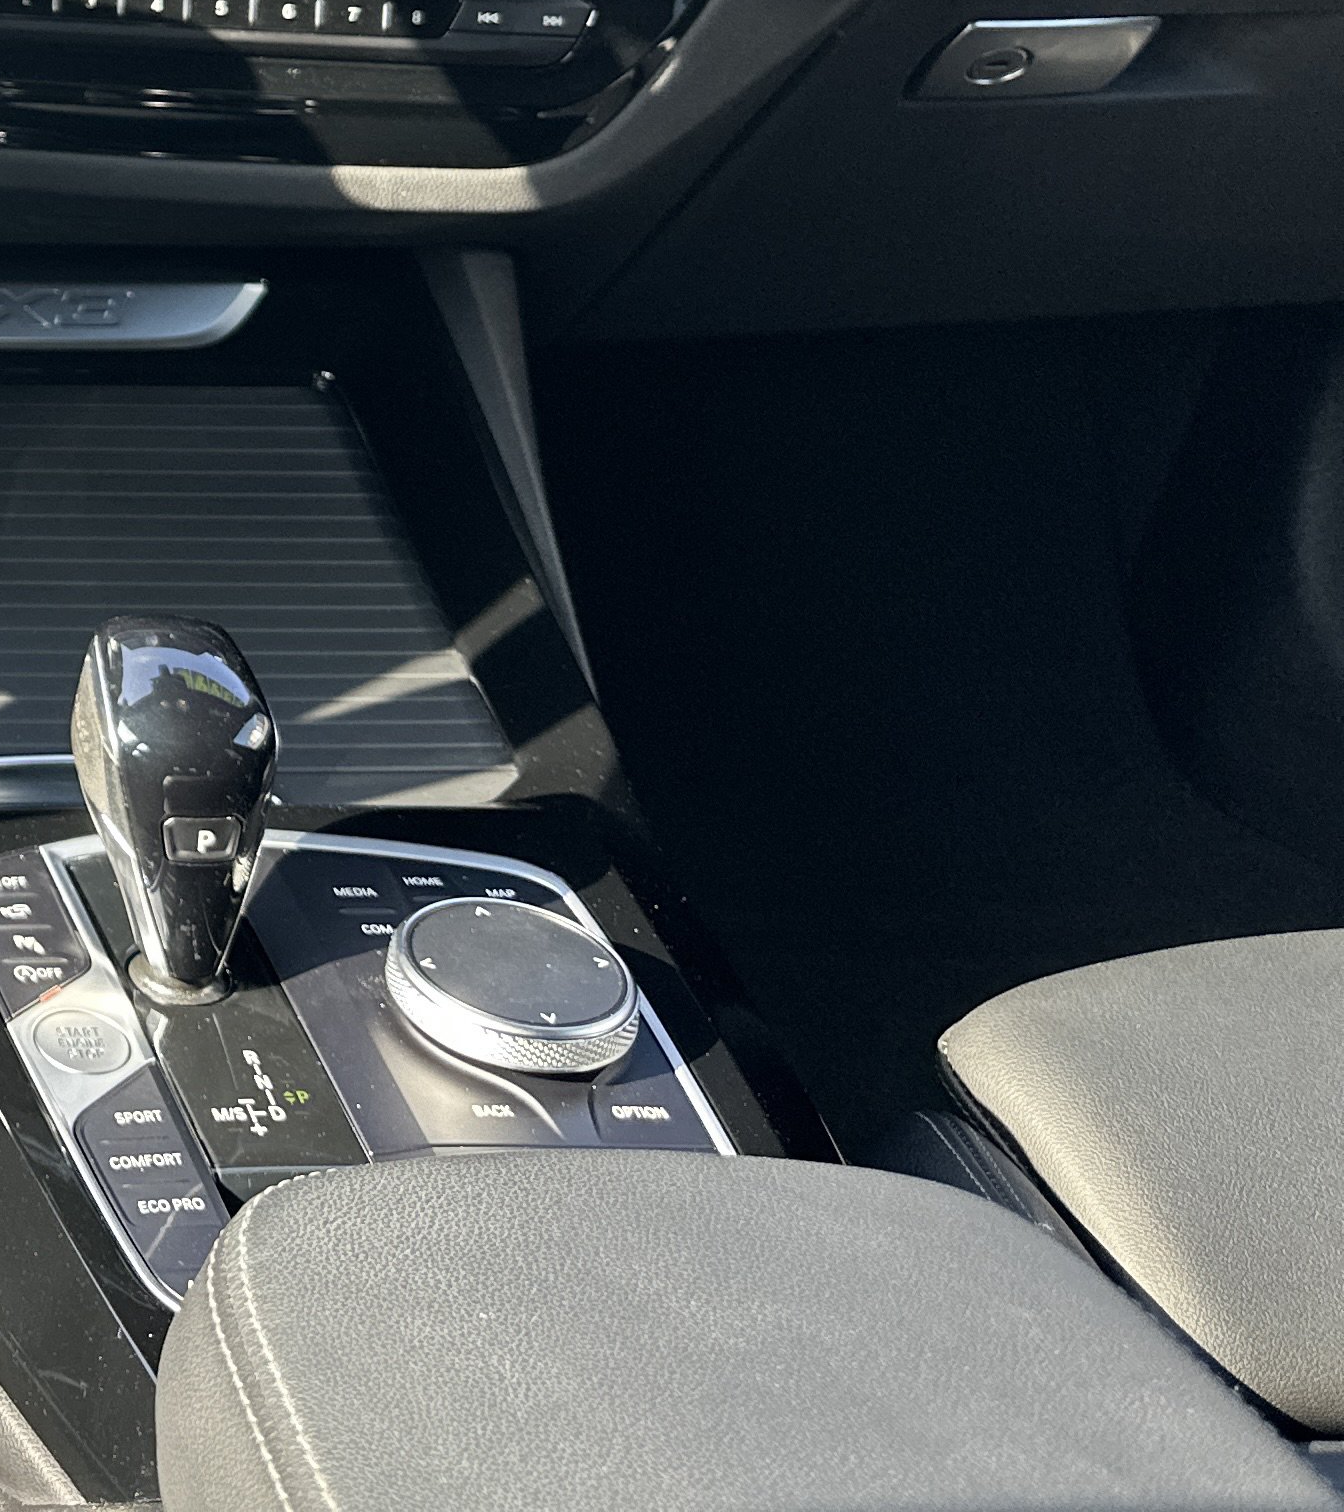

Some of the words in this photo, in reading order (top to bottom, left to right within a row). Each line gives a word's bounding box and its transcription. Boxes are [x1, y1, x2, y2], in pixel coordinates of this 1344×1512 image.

[196, 830, 217, 852] P
[1, 875, 28, 890] OFF
[401, 876, 444, 887] HOME
[332, 886, 378, 898] MEDIA
[484, 887, 516, 899] MAP
[36, 967, 63, 981] OFF
[56, 1025, 101, 1038] START
[242, 1049, 262, 1065] R
[253, 1074, 274, 1090] N
[295, 1090, 310, 1105] P
[114, 1109, 163, 1126] SPORT
[210, 1106, 249, 1123] M/S
[267, 1105, 288, 1123] D
[471, 1104, 515, 1119] BACK
[610, 1104, 671, 1121] OPTION
[108, 1152, 183, 1171] COMFORT
[137, 1199, 171, 1216] ECO
[171, 1196, 206, 1213] PRO
